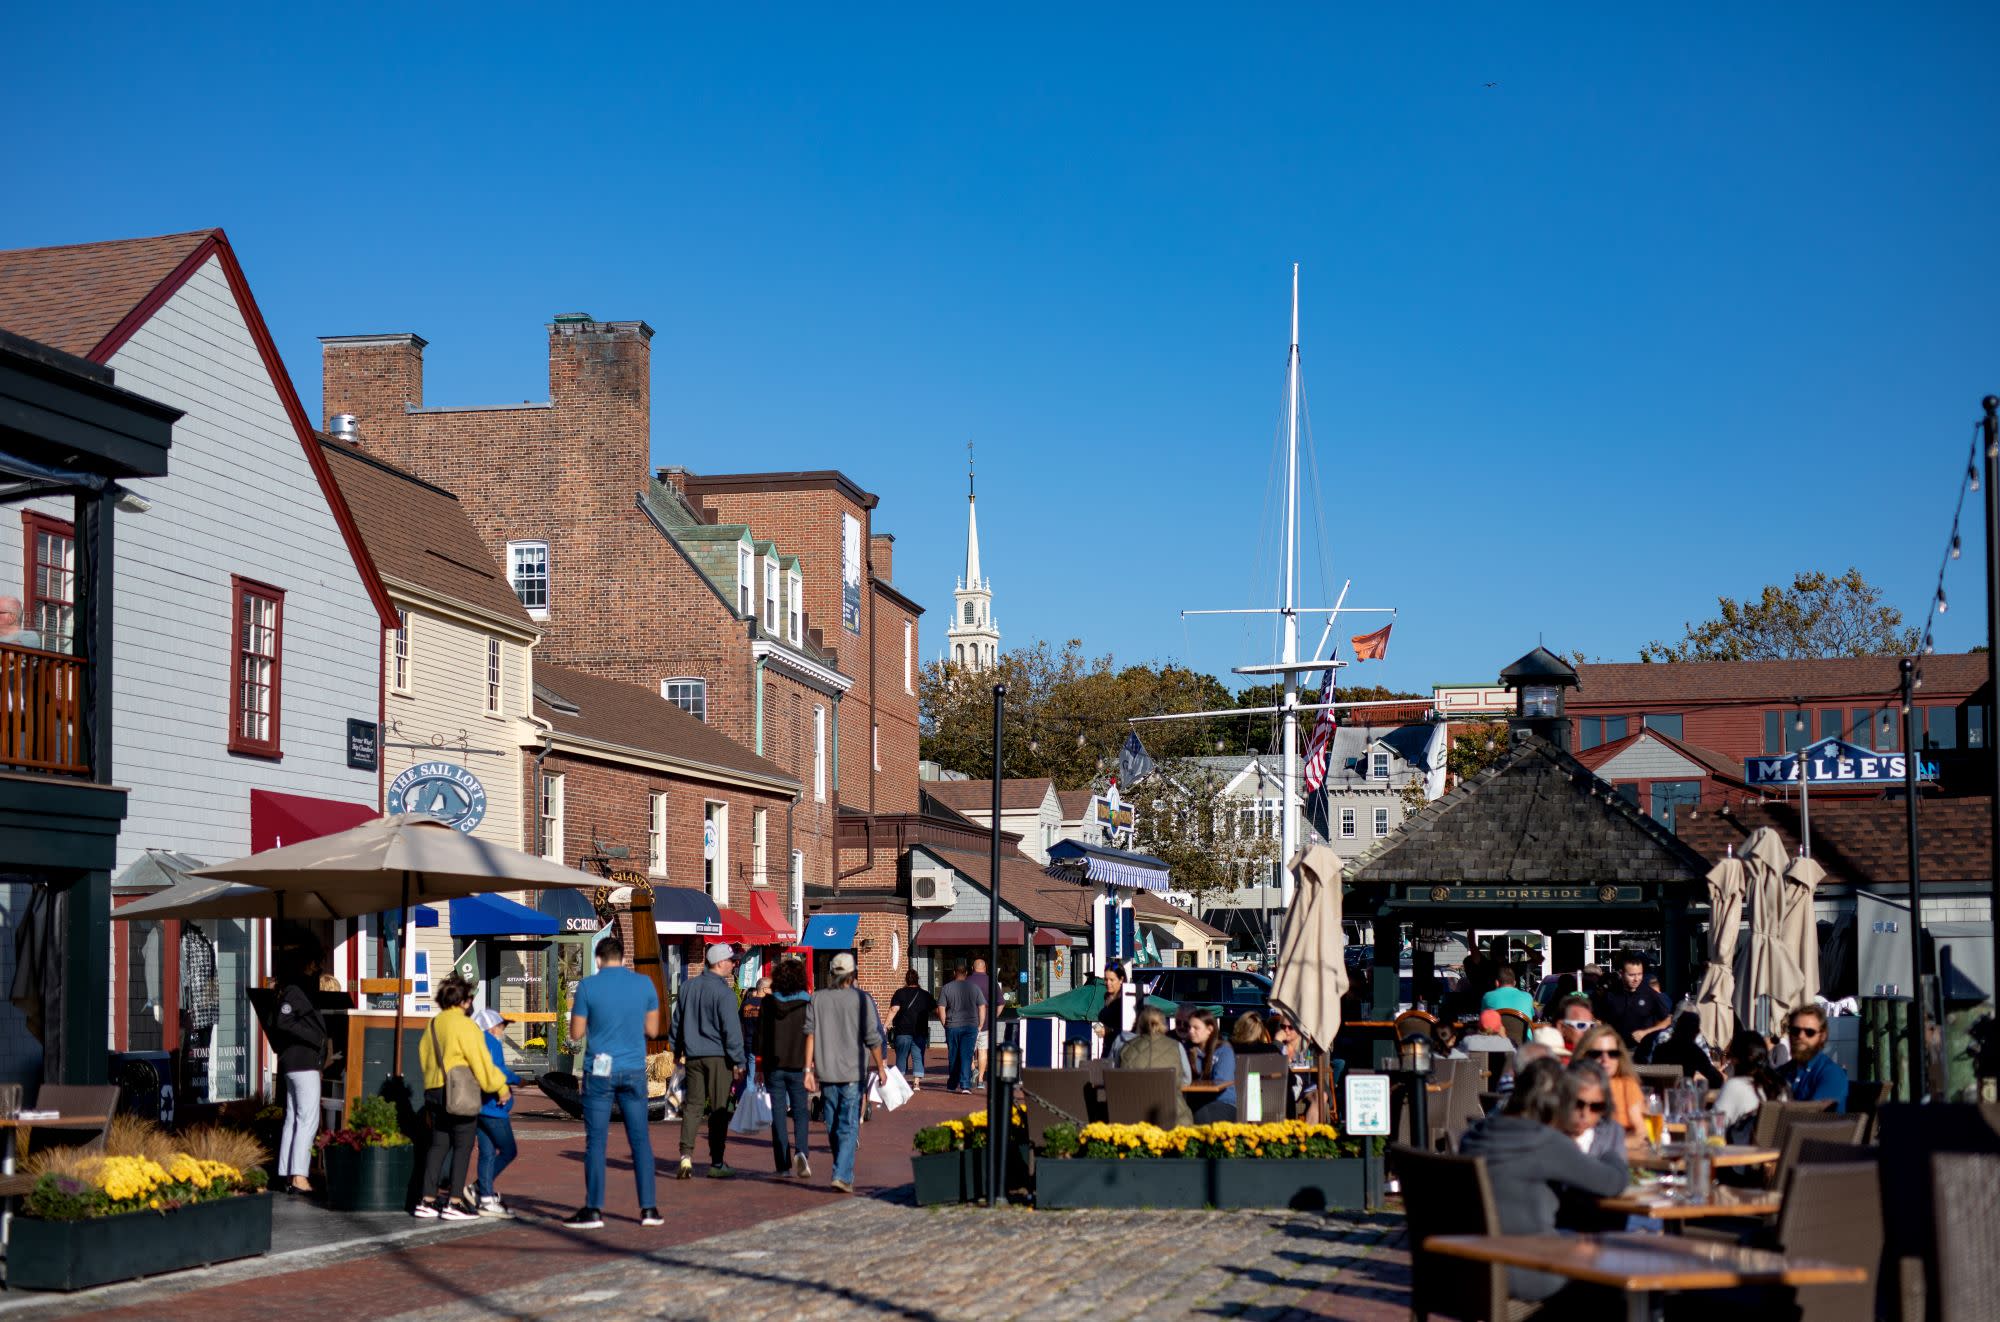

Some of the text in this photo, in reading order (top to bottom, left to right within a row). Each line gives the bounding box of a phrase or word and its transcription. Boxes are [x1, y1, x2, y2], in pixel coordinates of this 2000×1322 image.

[1757, 757, 1906, 781] MALEE'S
[391, 763, 485, 800] THE SAIL LOFT
[1466, 890, 1583, 898] 22 PORTSIDE
[461, 962, 474, 981] OP
[378, 1001, 396, 1009] OPEN
